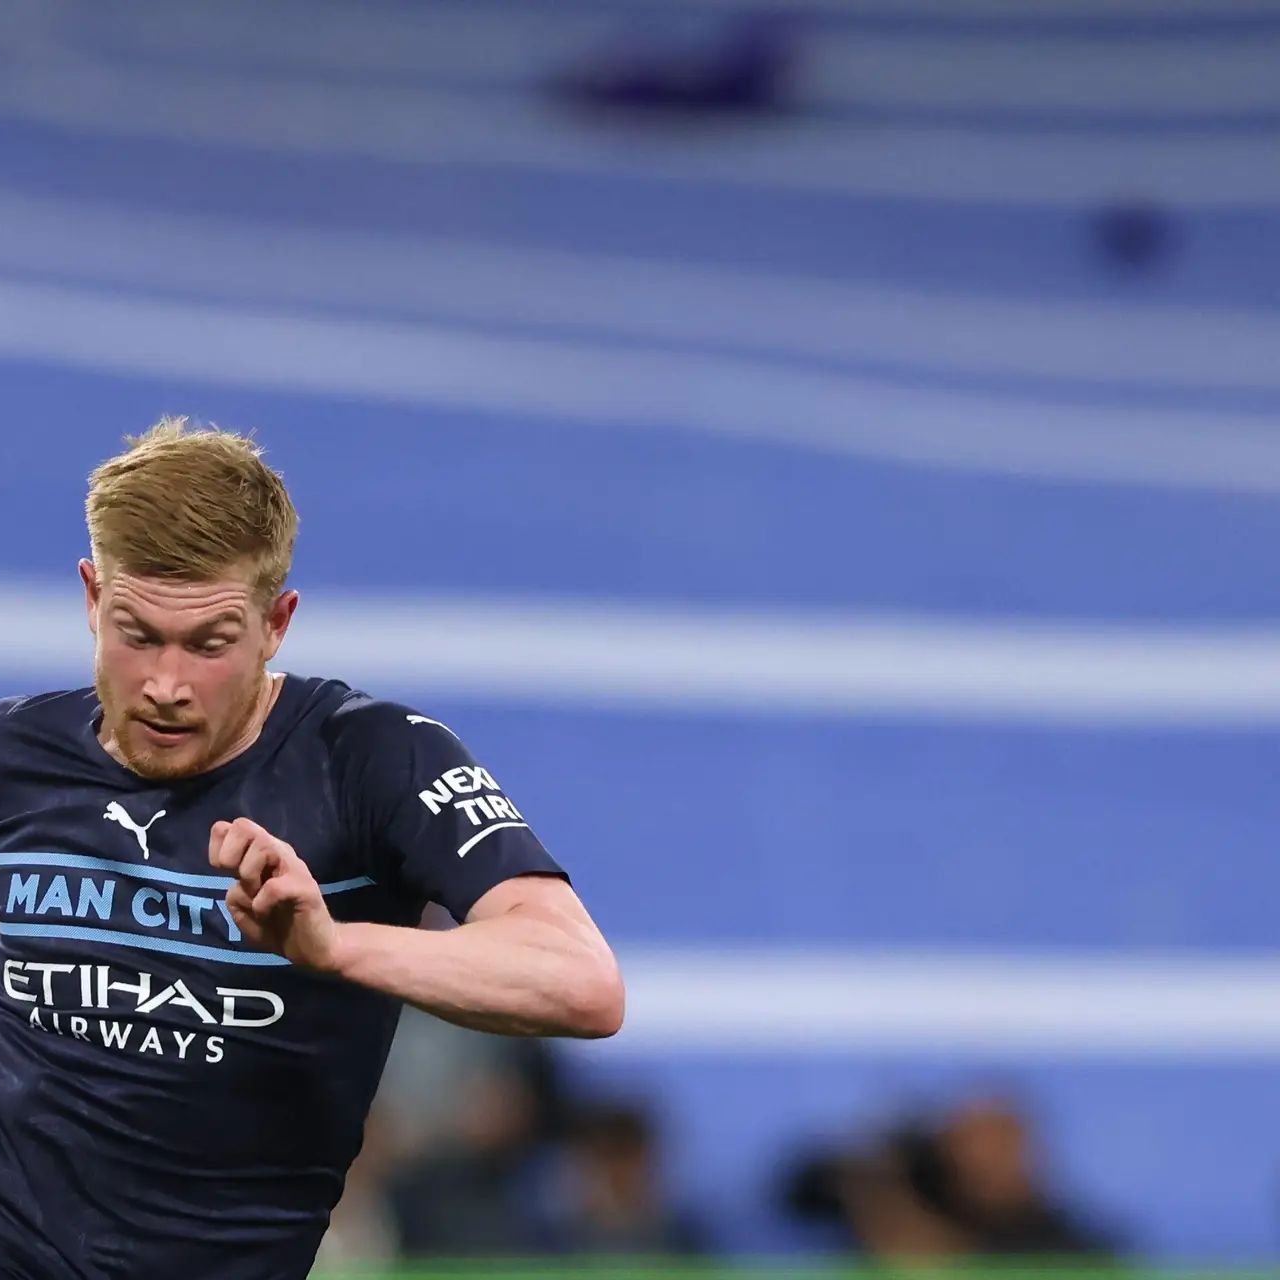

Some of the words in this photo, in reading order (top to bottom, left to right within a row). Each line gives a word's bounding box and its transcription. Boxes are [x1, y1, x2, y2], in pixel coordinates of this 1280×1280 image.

[5, 872, 116, 921] MAN
[131, 887, 243, 942] CITY
[2, 958, 285, 1028] ETIHAD
[28, 1006, 225, 1064] AIRWAYS
